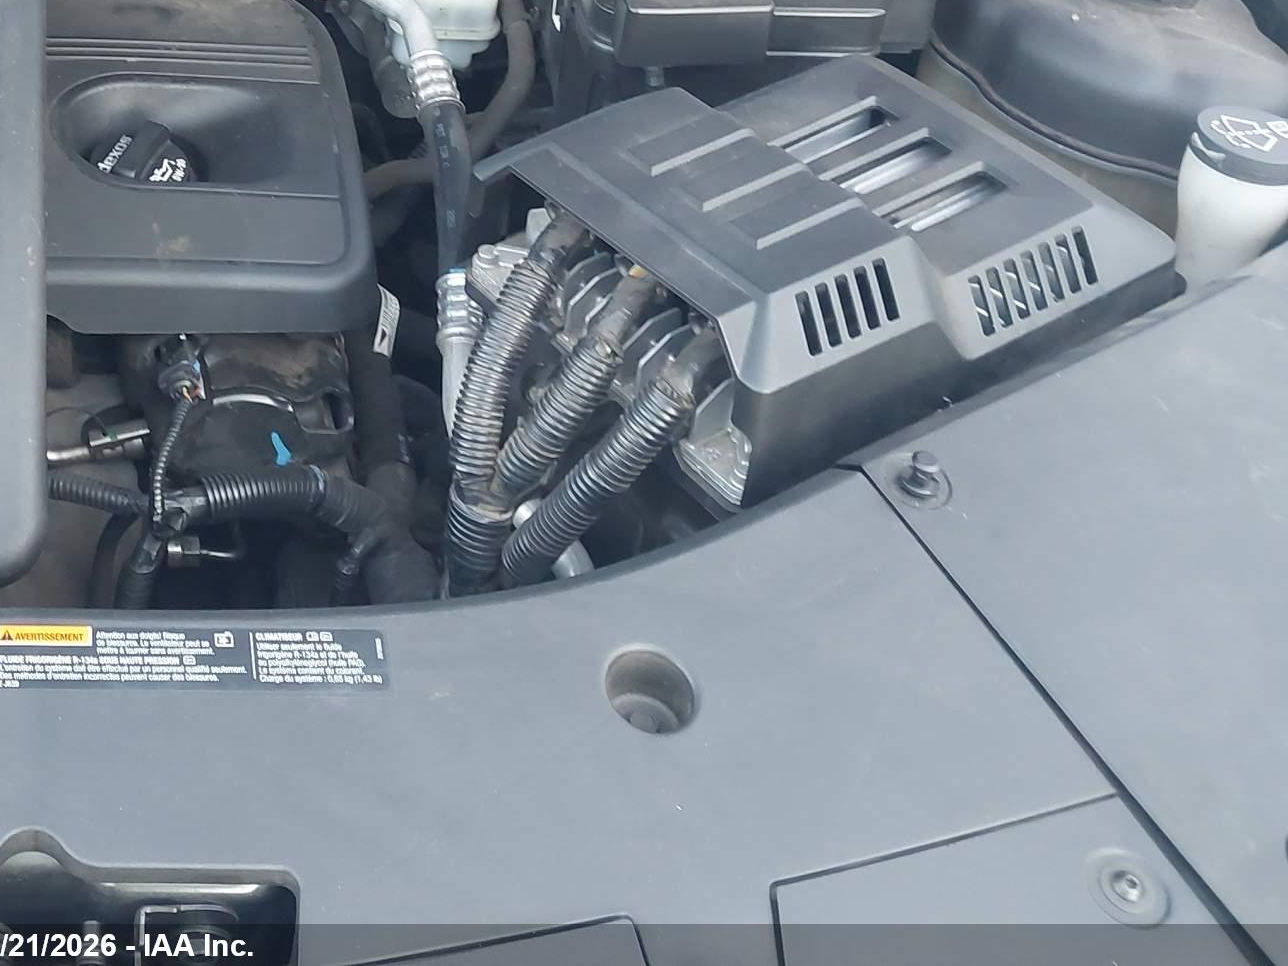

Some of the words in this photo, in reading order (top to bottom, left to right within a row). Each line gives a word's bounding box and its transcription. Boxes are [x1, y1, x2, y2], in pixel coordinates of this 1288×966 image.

[96, 134, 133, 174] dexos
[15, 633, 83, 641] AVERTISSEMENT
[96, 631, 125, 639] Attention
[185, 640, 200, 648] peut
[294, 651, 319, 659] R-134a
[0, 655, 24, 663] FLUIDE
[99, 656, 118, 664] SOUS
[120, 656, 143, 664] HAUTE
[144, 656, 180, 665] PRESSION
[130, 666, 140, 674] par
[152, 665, 184, 673] personnel
[344, 676, 353, 684] kg
